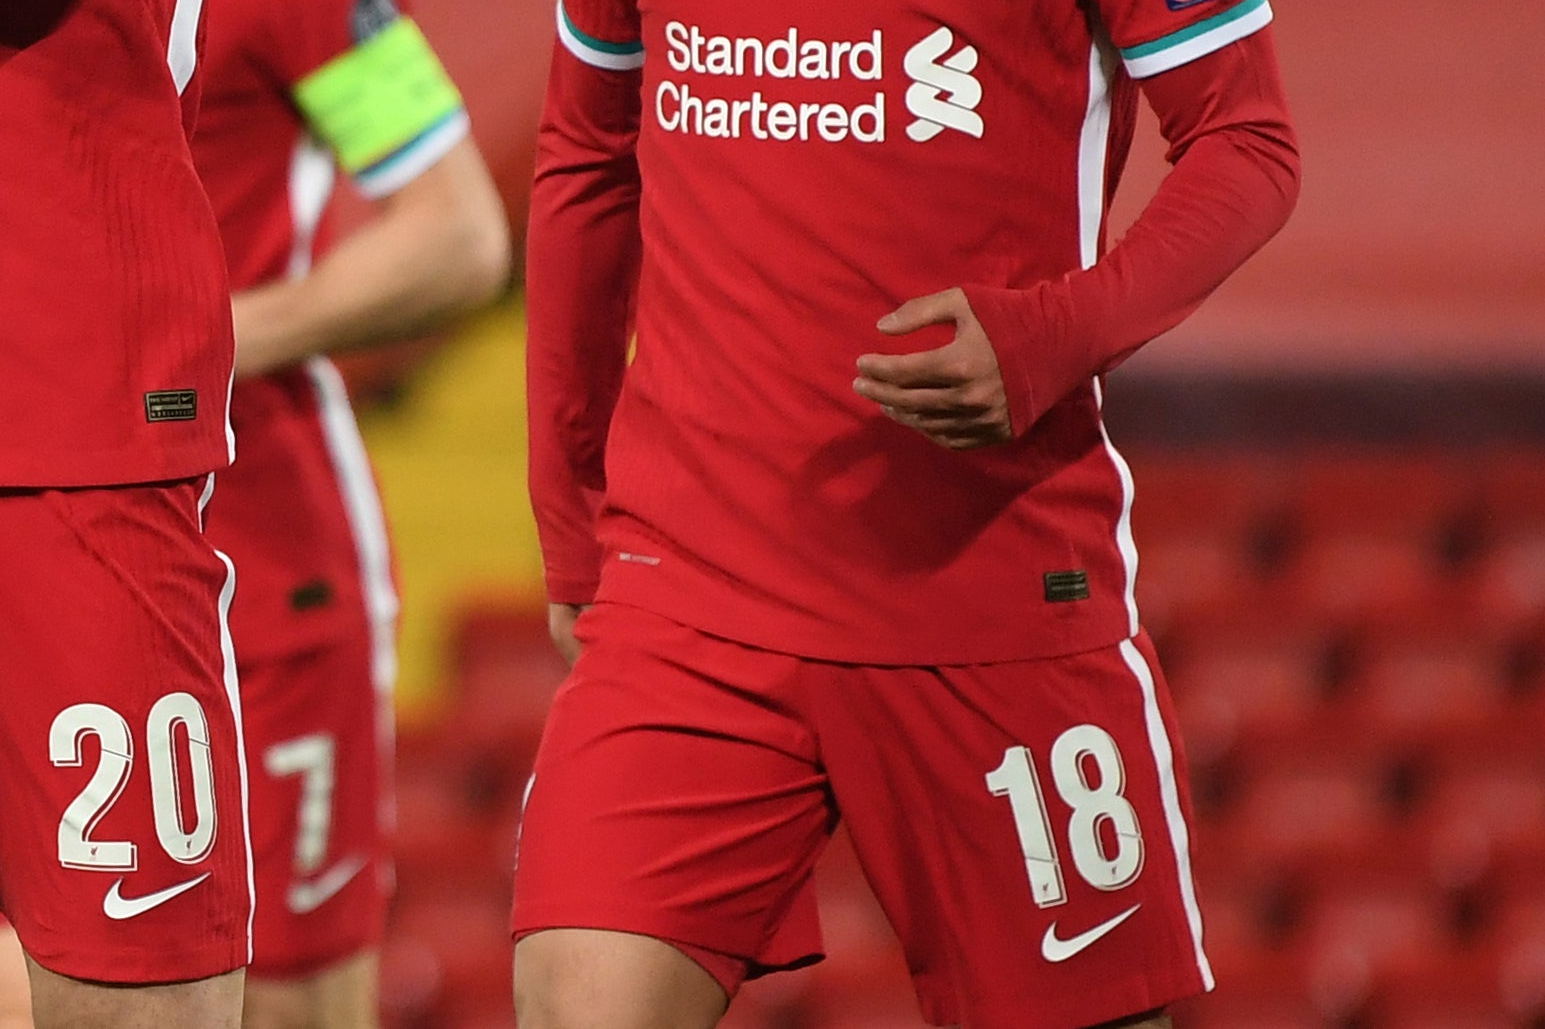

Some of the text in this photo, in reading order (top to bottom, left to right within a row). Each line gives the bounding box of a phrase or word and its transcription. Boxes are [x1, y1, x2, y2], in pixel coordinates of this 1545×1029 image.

[655, 80, 885, 142] Chartered
[665, 20, 882, 80] Standard
[48, 691, 218, 872] 20
[264, 733, 335, 873] 7
[985, 723, 1146, 909] 18
